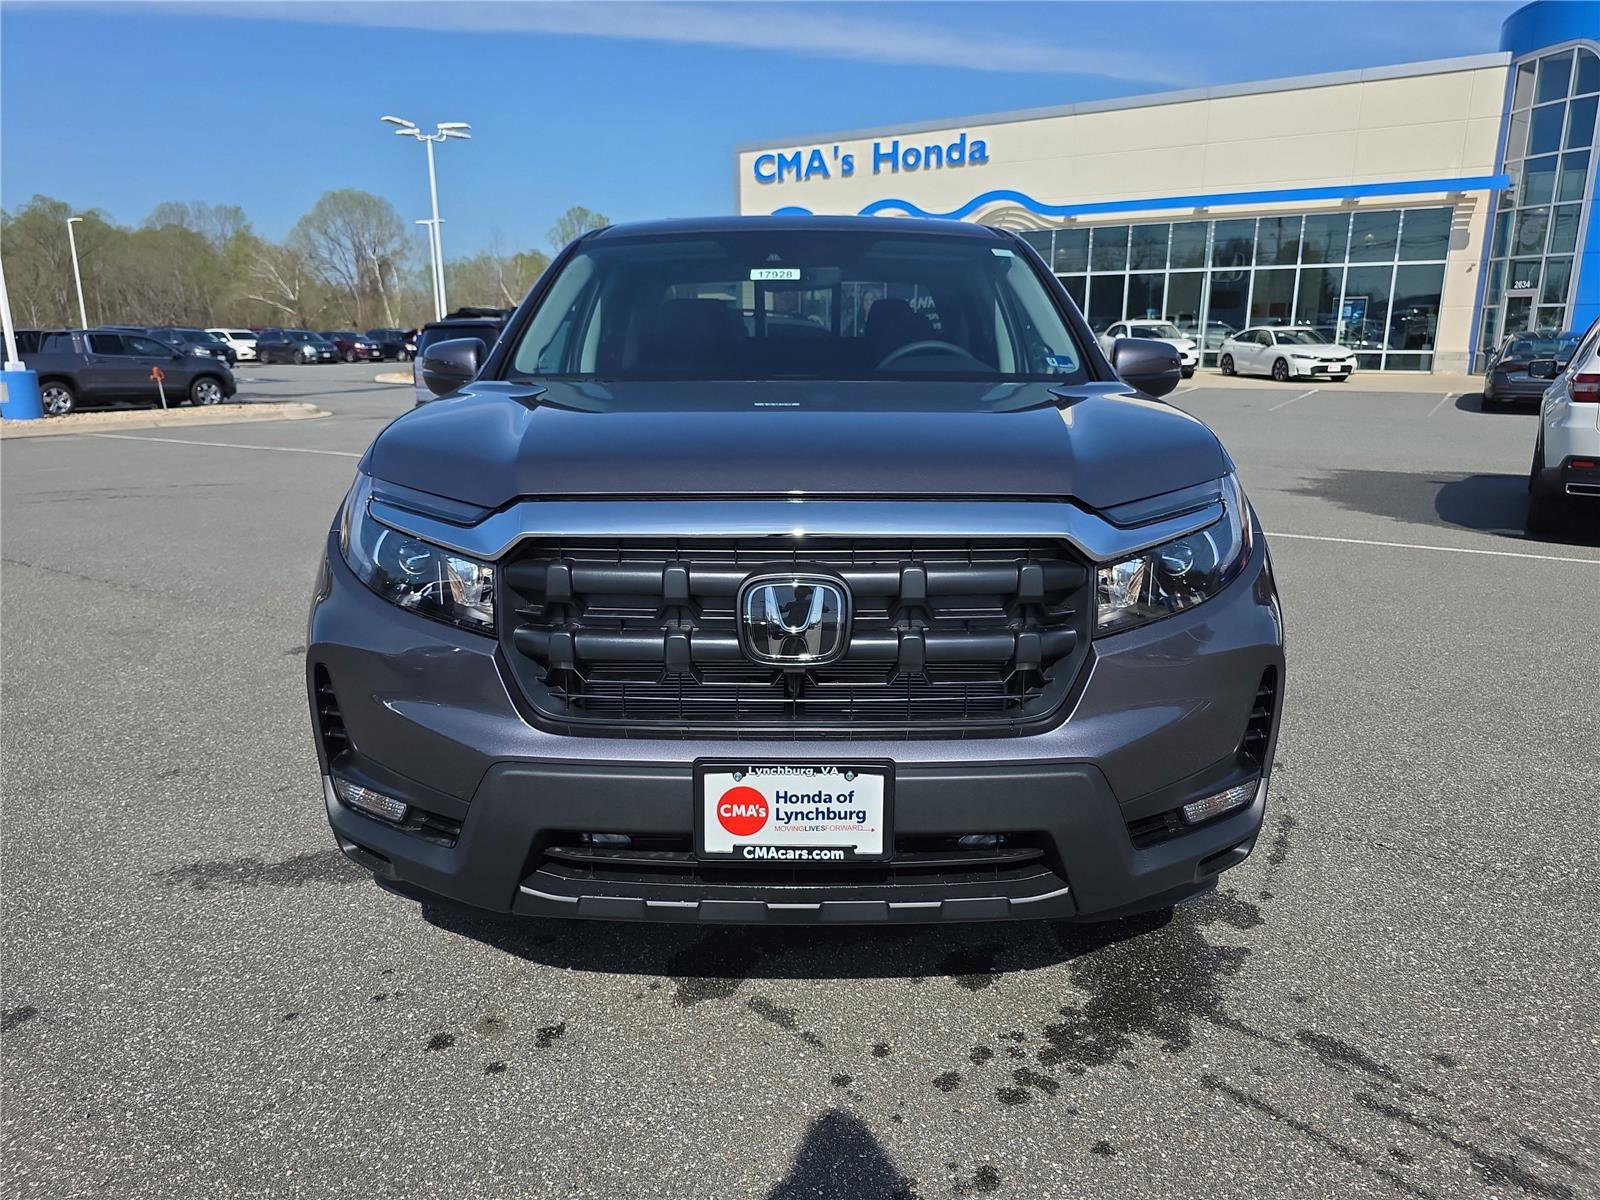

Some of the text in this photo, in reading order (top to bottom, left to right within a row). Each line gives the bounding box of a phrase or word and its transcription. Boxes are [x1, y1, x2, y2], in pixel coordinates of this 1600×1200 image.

[753, 132, 990, 183] CMA's Honda
[758, 270, 793, 279] 17928
[748, 766, 839, 777] Lynchburg, VA
[775, 790, 855, 804] Honda of
[719, 803, 767, 818] CMA's
[775, 807, 867, 824] Lynchburg
[743, 846, 845, 860] CMAcars.com
